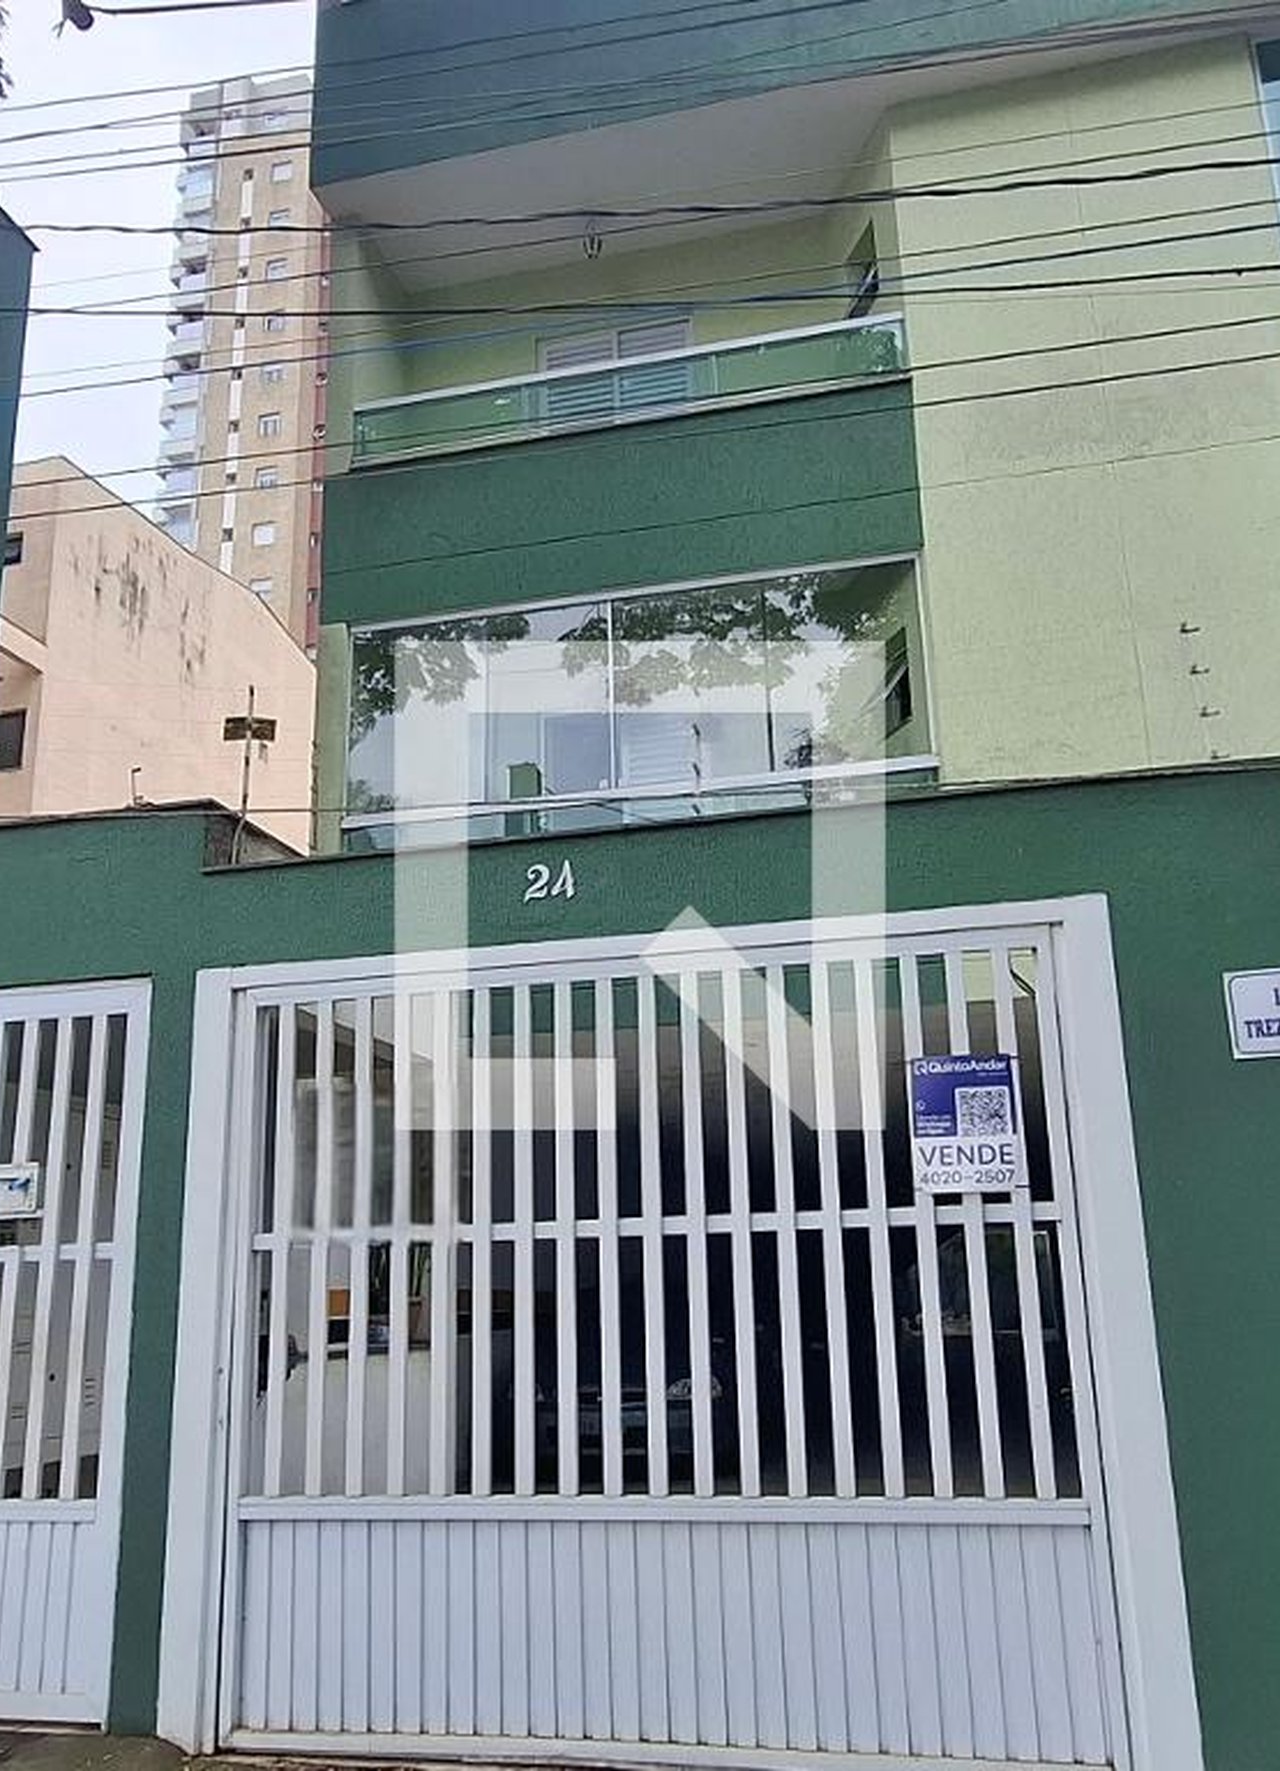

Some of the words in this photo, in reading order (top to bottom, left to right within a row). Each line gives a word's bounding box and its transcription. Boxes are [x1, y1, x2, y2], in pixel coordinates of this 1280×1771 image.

[523, 859, 575, 904] 24
[928, 1058, 1008, 1073] QuintoAndar
[918, 1143, 1015, 1167] VENDE
[920, 1169, 1015, 1185] 4020-2507
